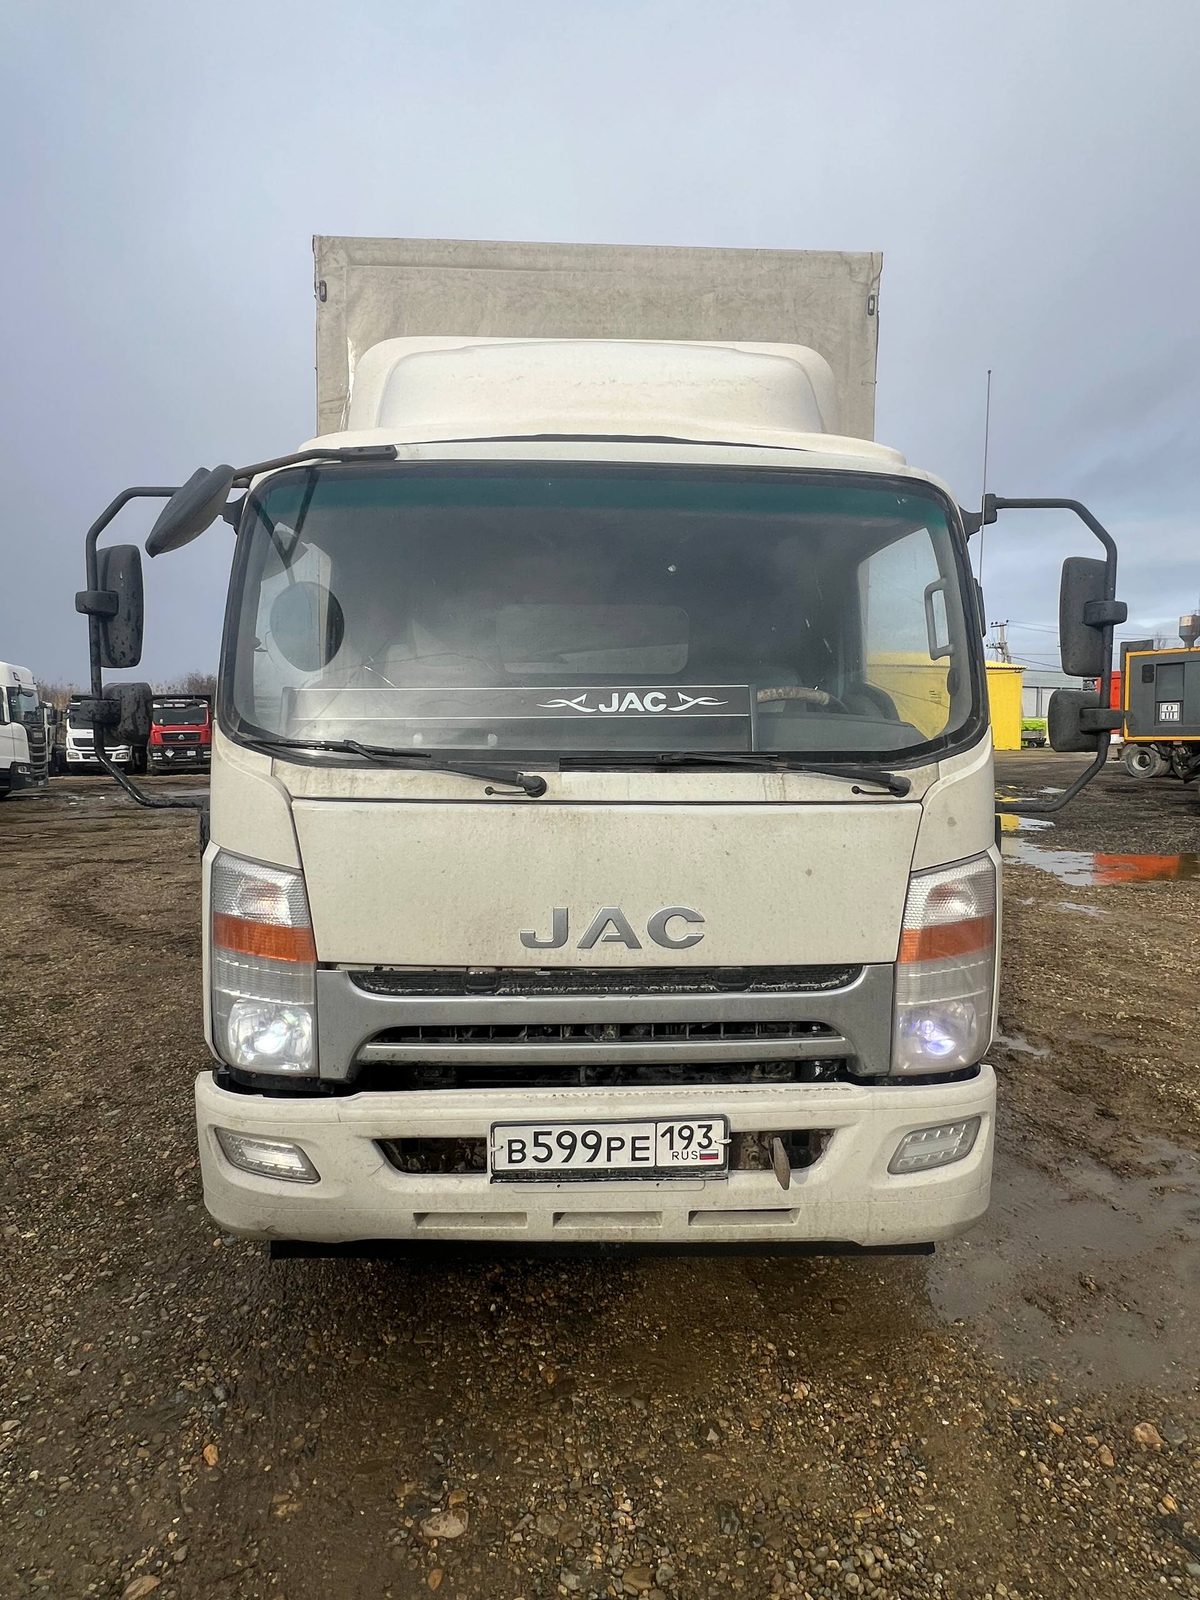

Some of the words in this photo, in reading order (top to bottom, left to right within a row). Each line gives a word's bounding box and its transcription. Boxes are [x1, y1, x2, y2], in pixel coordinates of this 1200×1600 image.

[598, 692, 667, 712] JAC
[519, 905, 706, 950] JAC
[660, 1124, 713, 1150] 193
[671, 1150, 698, 1161] RUS
